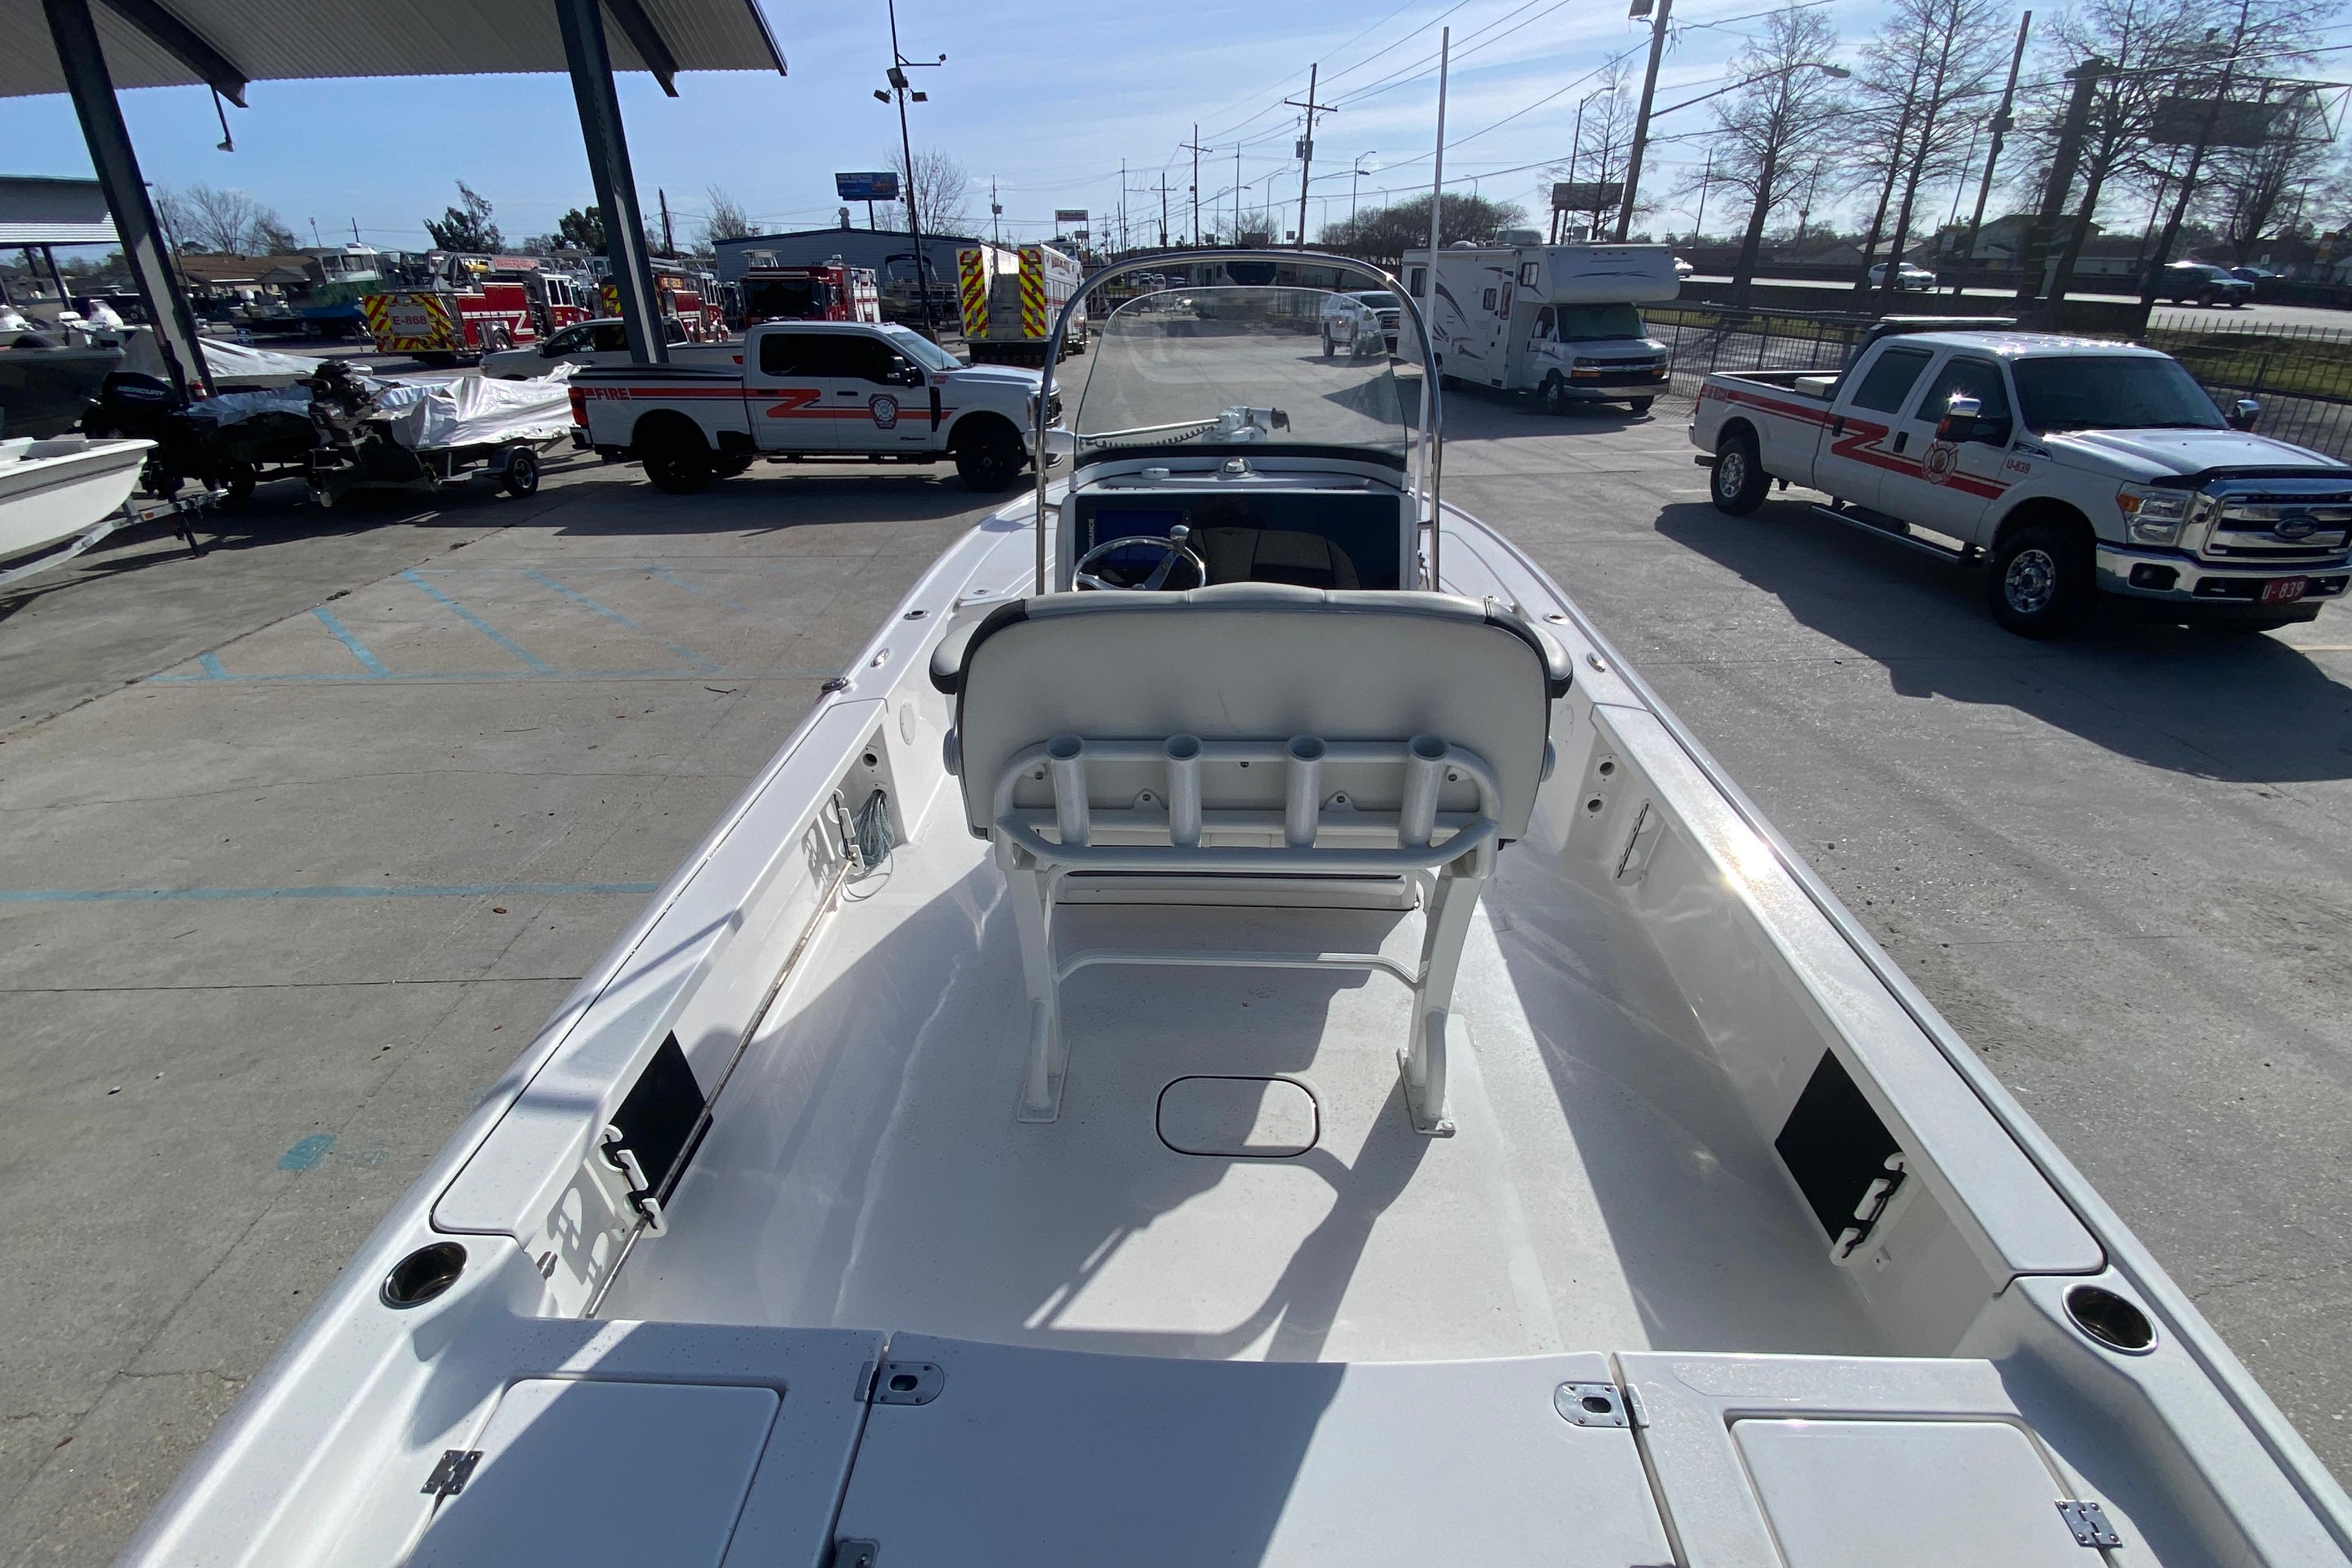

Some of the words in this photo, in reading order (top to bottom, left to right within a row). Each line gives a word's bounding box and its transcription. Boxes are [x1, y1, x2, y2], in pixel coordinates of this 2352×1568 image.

[392, 316, 427, 325] E-868
[117, 386, 165, 396] MERCURY
[594, 387, 631, 401] FIRE
[2007, 459, 2031, 474] U-839
[2262, 581, 2304, 600] U-839
